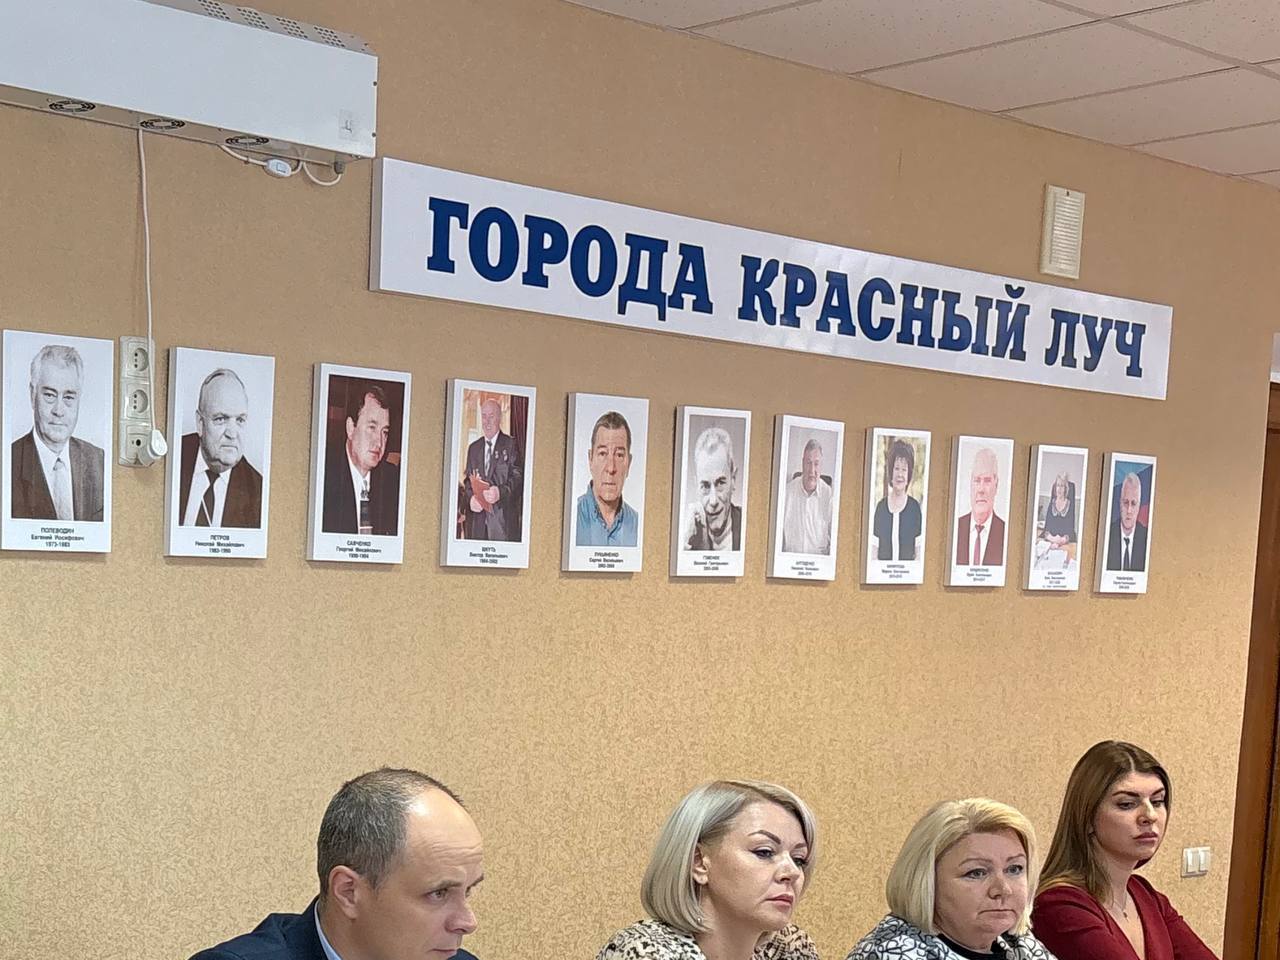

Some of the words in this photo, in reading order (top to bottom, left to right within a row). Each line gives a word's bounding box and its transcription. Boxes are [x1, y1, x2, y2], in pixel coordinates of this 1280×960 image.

[426, 197, 713, 322] ГОРОДА
[738, 255, 1028, 361] КРАСНЫЙ
[1044, 307, 1147, 379] ЛУЧ
